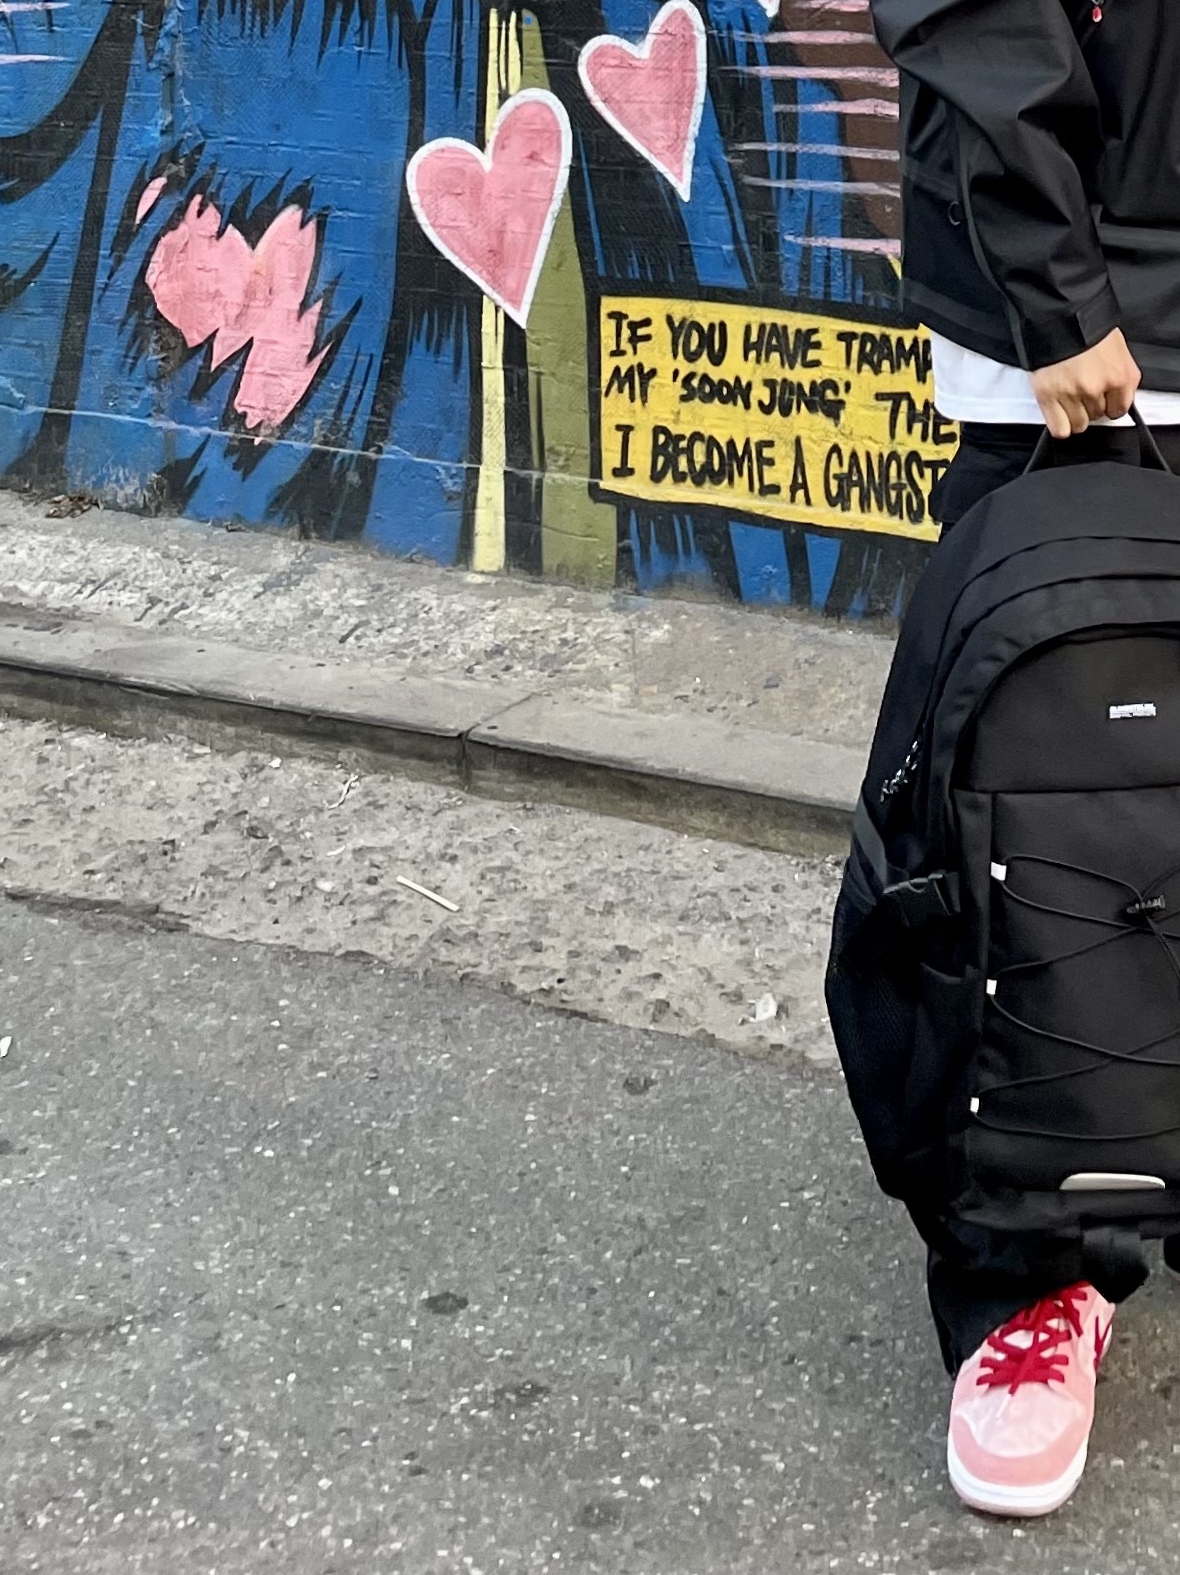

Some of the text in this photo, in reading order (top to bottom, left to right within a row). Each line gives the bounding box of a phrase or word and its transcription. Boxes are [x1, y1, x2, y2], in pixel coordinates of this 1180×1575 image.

[606, 311, 652, 357] IF
[666, 314, 727, 366] YOU
[743, 322, 822, 369] HAVE
[604, 362, 657, 406] MY
[611, 425, 635, 478] I
[650, 426, 781, 497] BECOME
[790, 436, 812, 506] A
